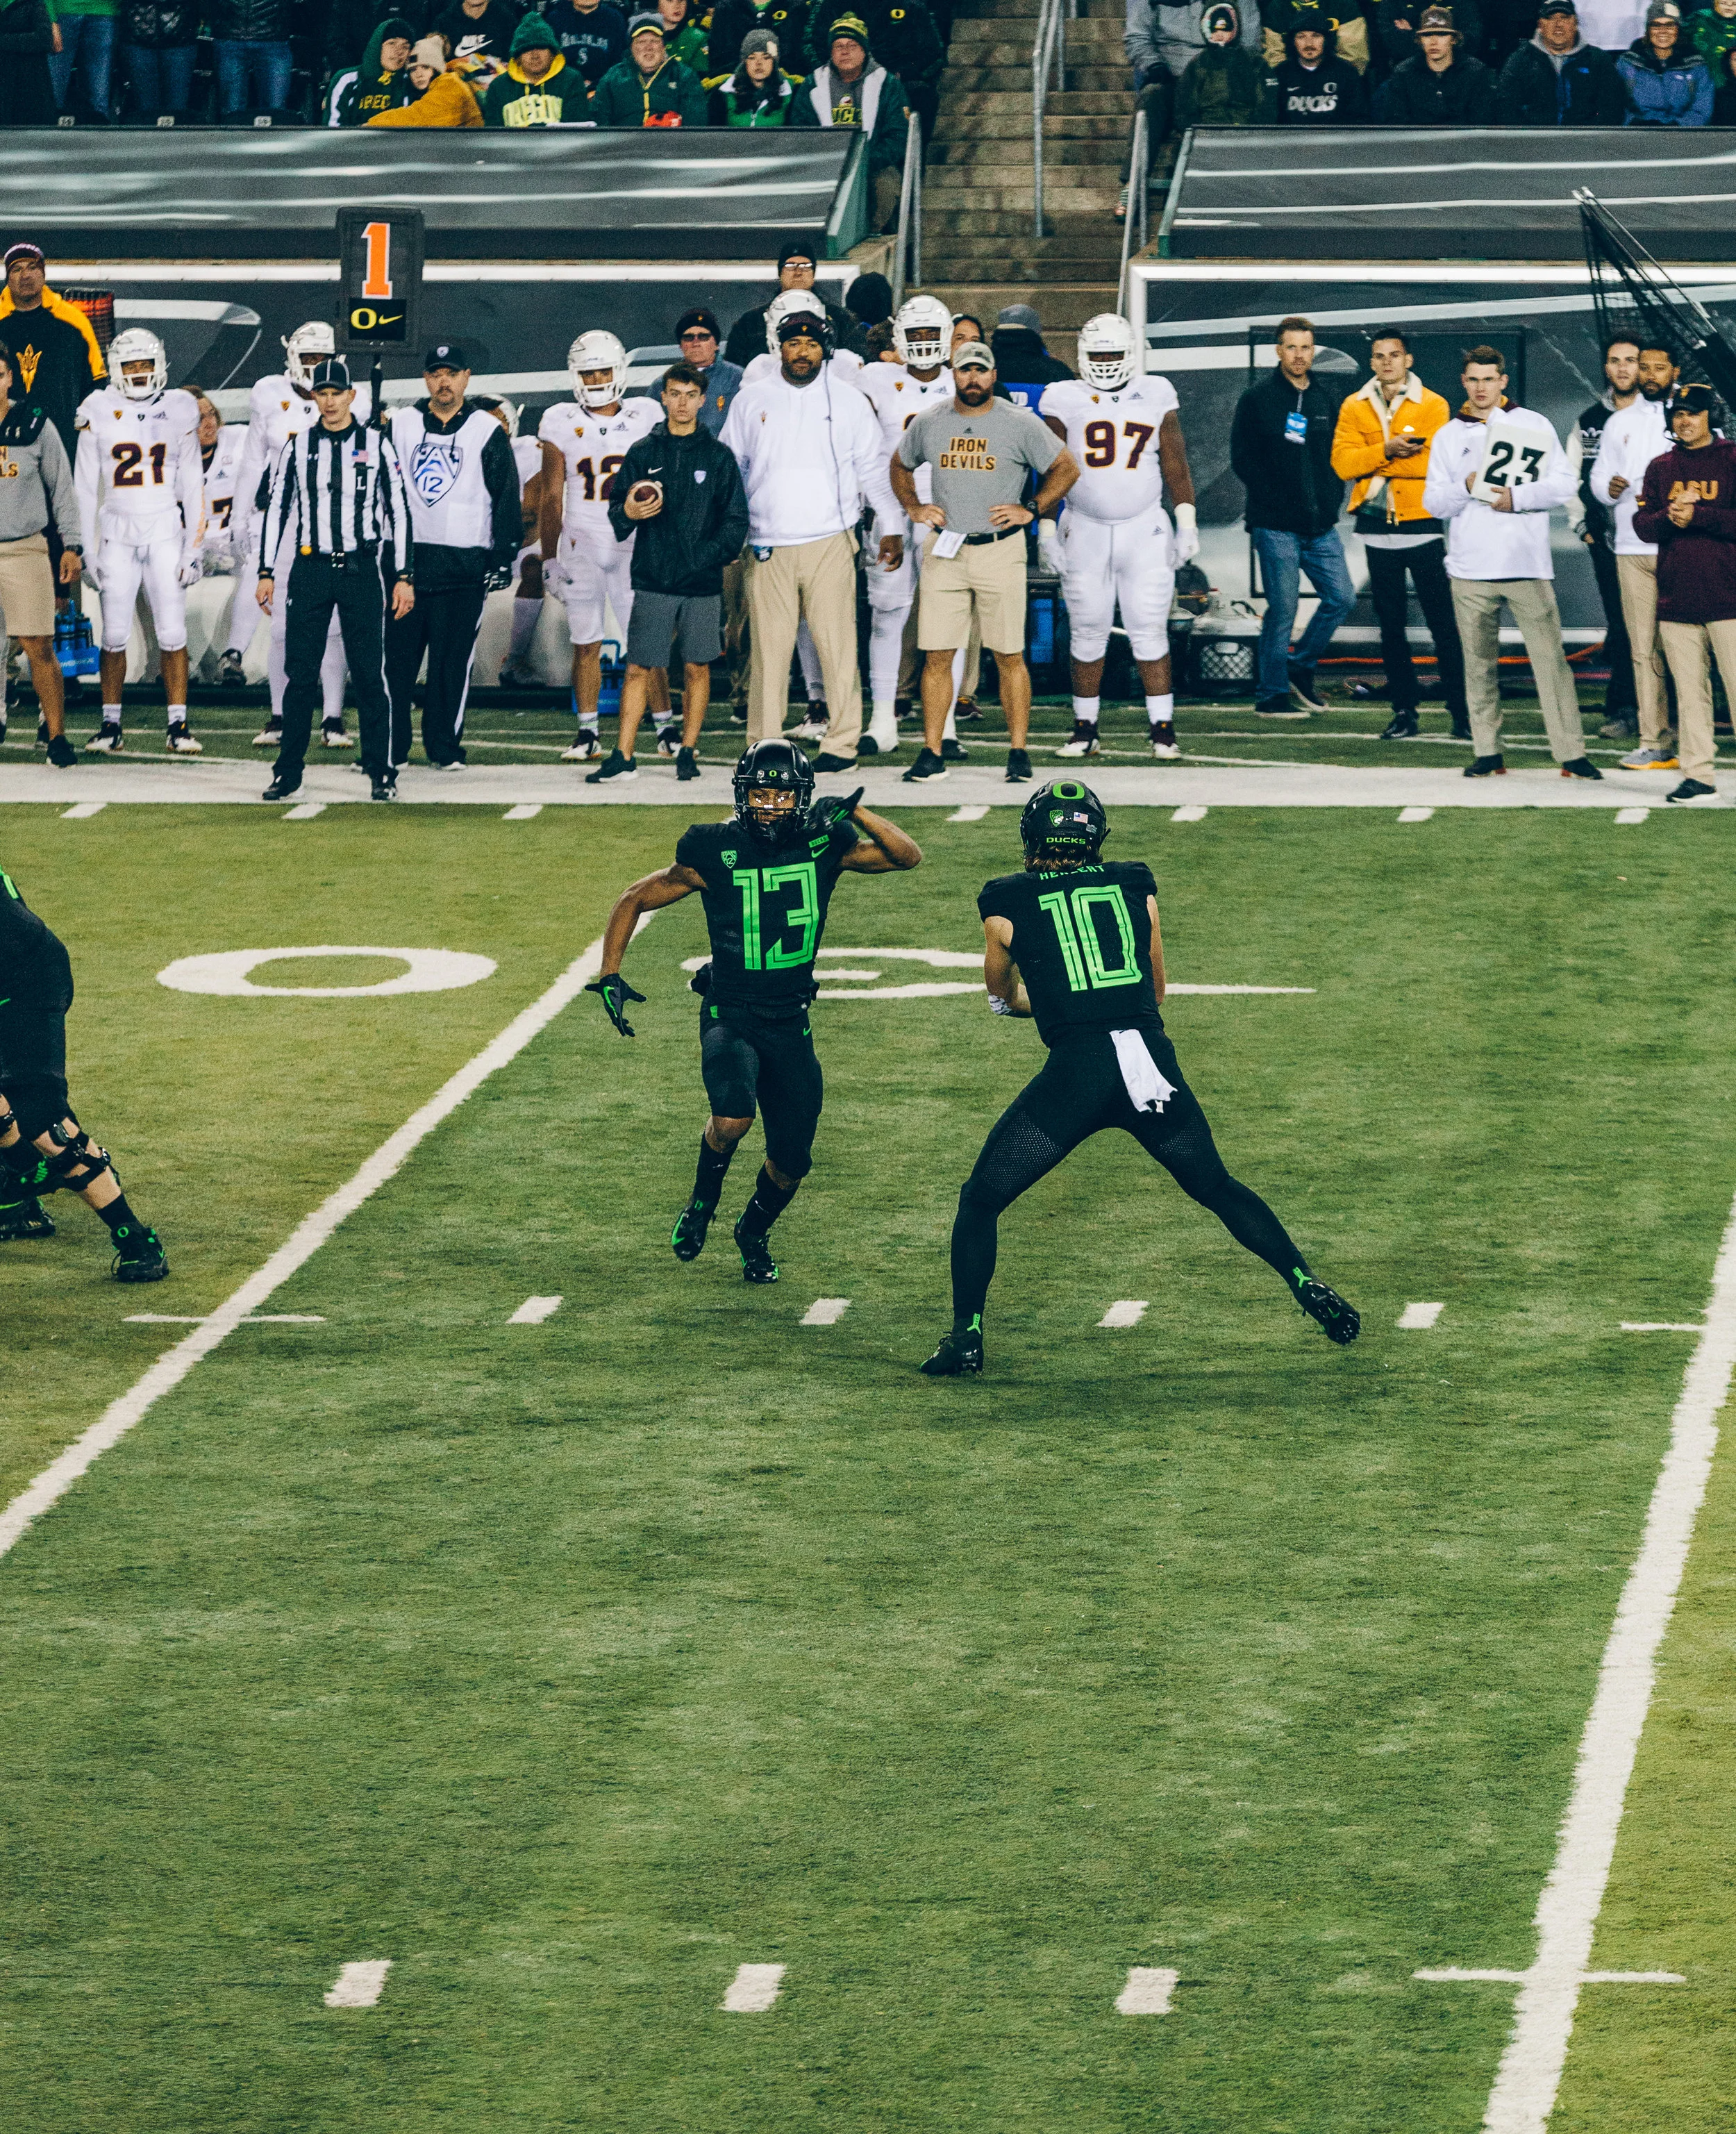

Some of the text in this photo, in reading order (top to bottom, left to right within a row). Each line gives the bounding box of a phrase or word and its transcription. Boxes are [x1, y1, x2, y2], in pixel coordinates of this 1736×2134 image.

[1287, 94, 1339, 112] DUCKS
[360, 221, 394, 300] 1
[350, 307, 377, 330] O
[949, 436, 989, 453] IRON
[1084, 419, 1155, 471] 97
[111, 442, 167, 488] 21
[939, 453, 997, 472] DEVILS
[1483, 440, 1546, 487] 23
[356, 475, 366, 491] L
[422, 476, 444, 493] 12
[576, 453, 626, 501] 12
[1668, 480, 1719, 500] ASU
[206, 496, 233, 530] 7
[1053, 781, 1085, 800] O
[1046, 836, 1086, 845] DUCKS
[733, 861, 819, 971] 13
[1038, 884, 1143, 992] 10
